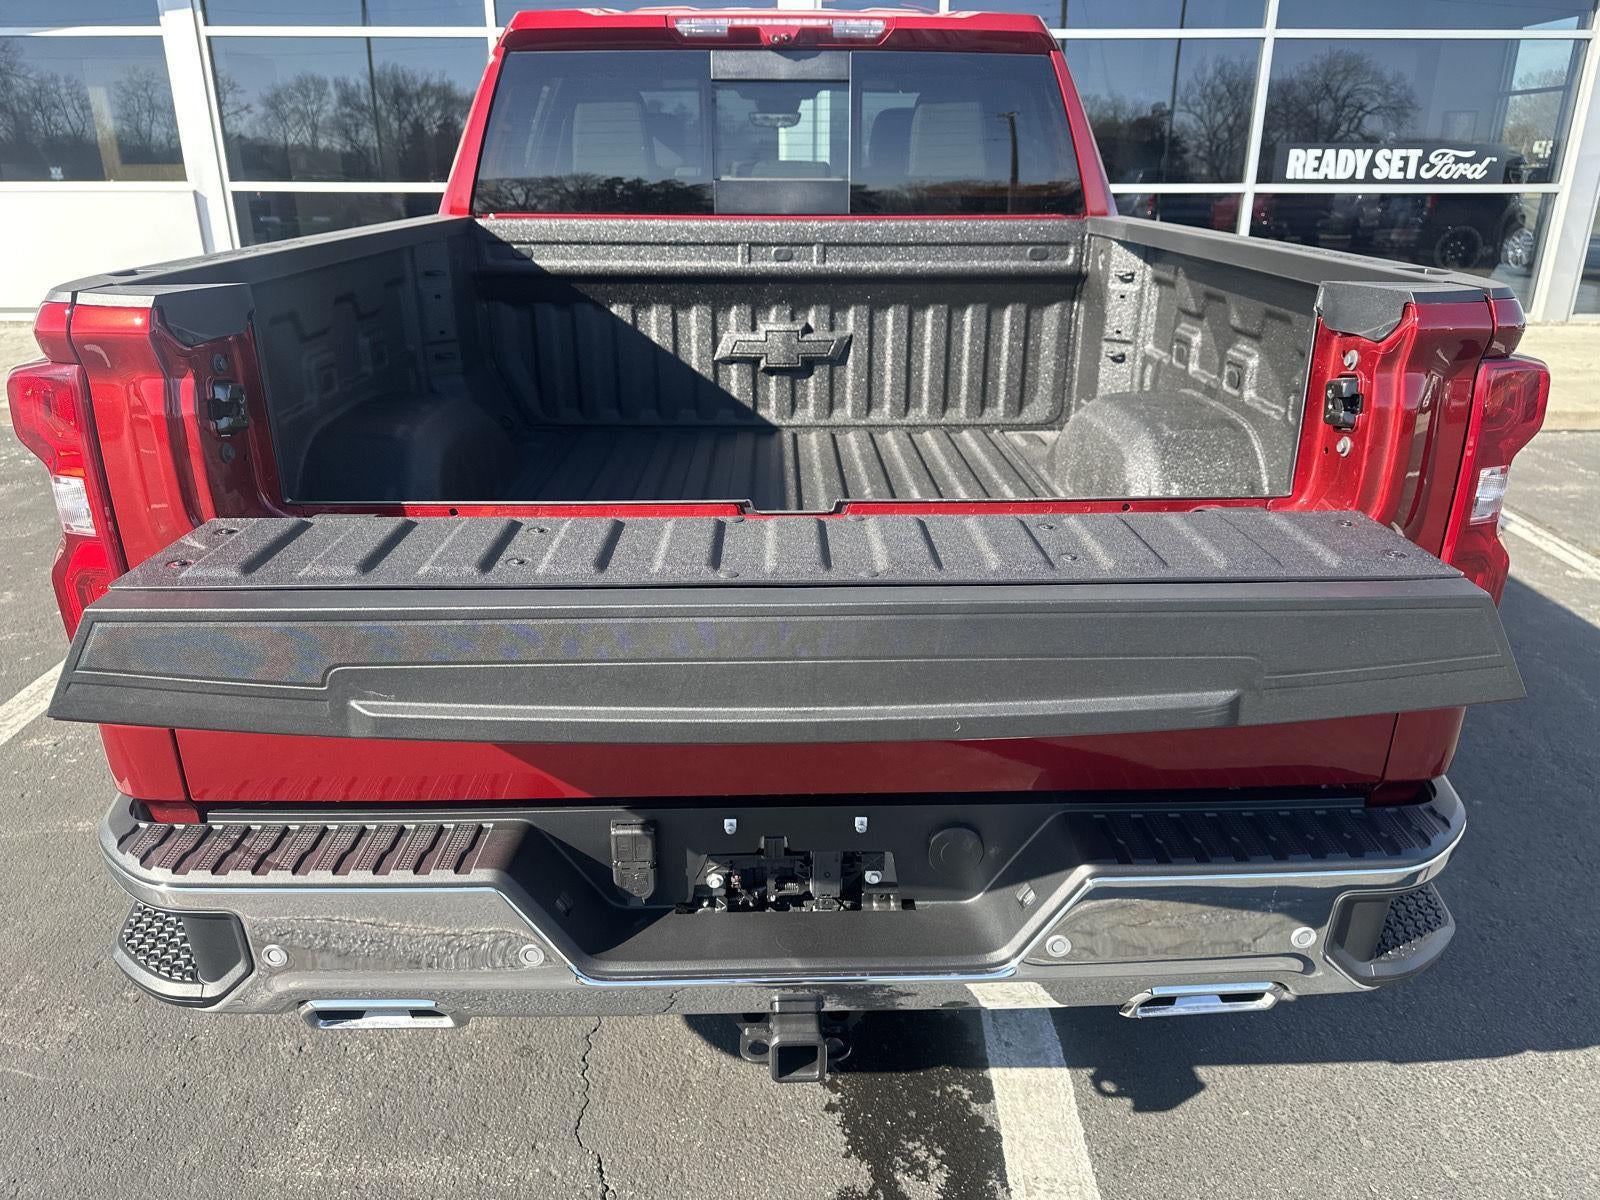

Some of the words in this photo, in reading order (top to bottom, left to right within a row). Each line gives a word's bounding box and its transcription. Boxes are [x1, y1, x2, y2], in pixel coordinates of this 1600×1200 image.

[1286, 148, 1373, 180] READY
[1372, 148, 1423, 180] SET
[1419, 148, 1489, 180] Ford
